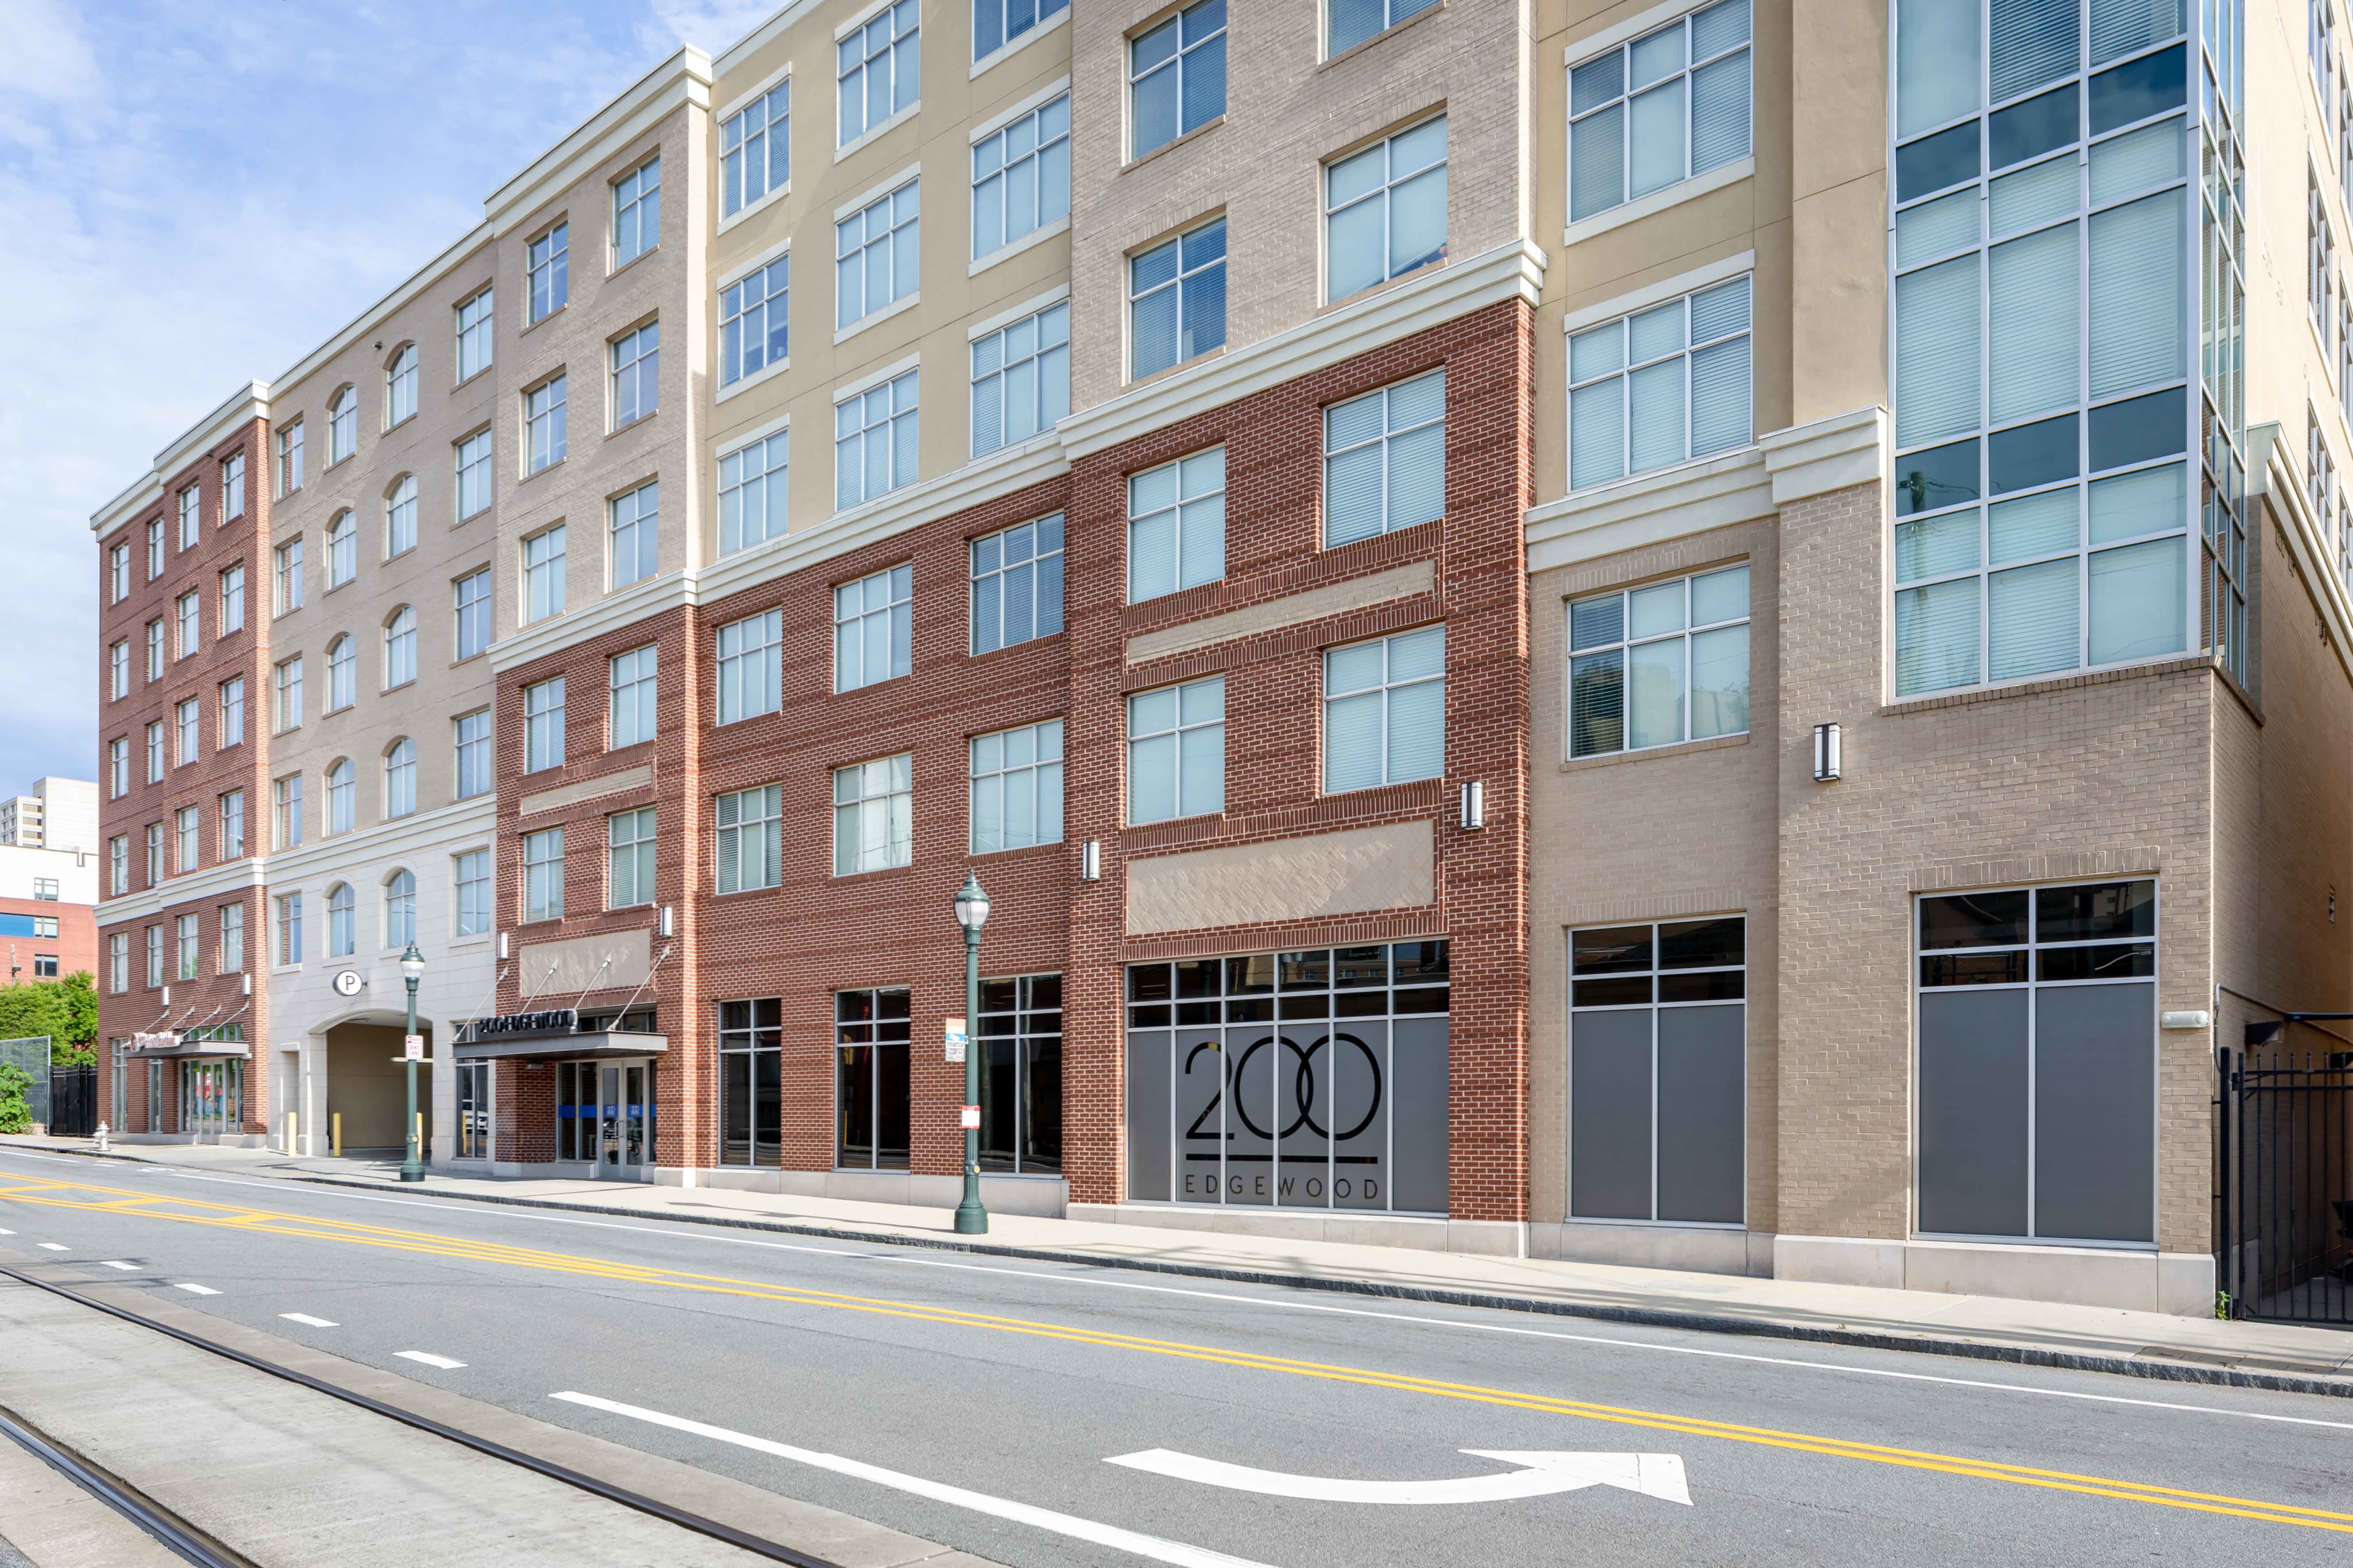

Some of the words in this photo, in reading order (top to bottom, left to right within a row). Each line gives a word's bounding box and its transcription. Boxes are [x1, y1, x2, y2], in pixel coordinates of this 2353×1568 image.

[346, 975, 355, 991] P
[1185, 1033, 1382, 1141] 200
[1185, 1175, 1378, 1199] EDGEWOOD
